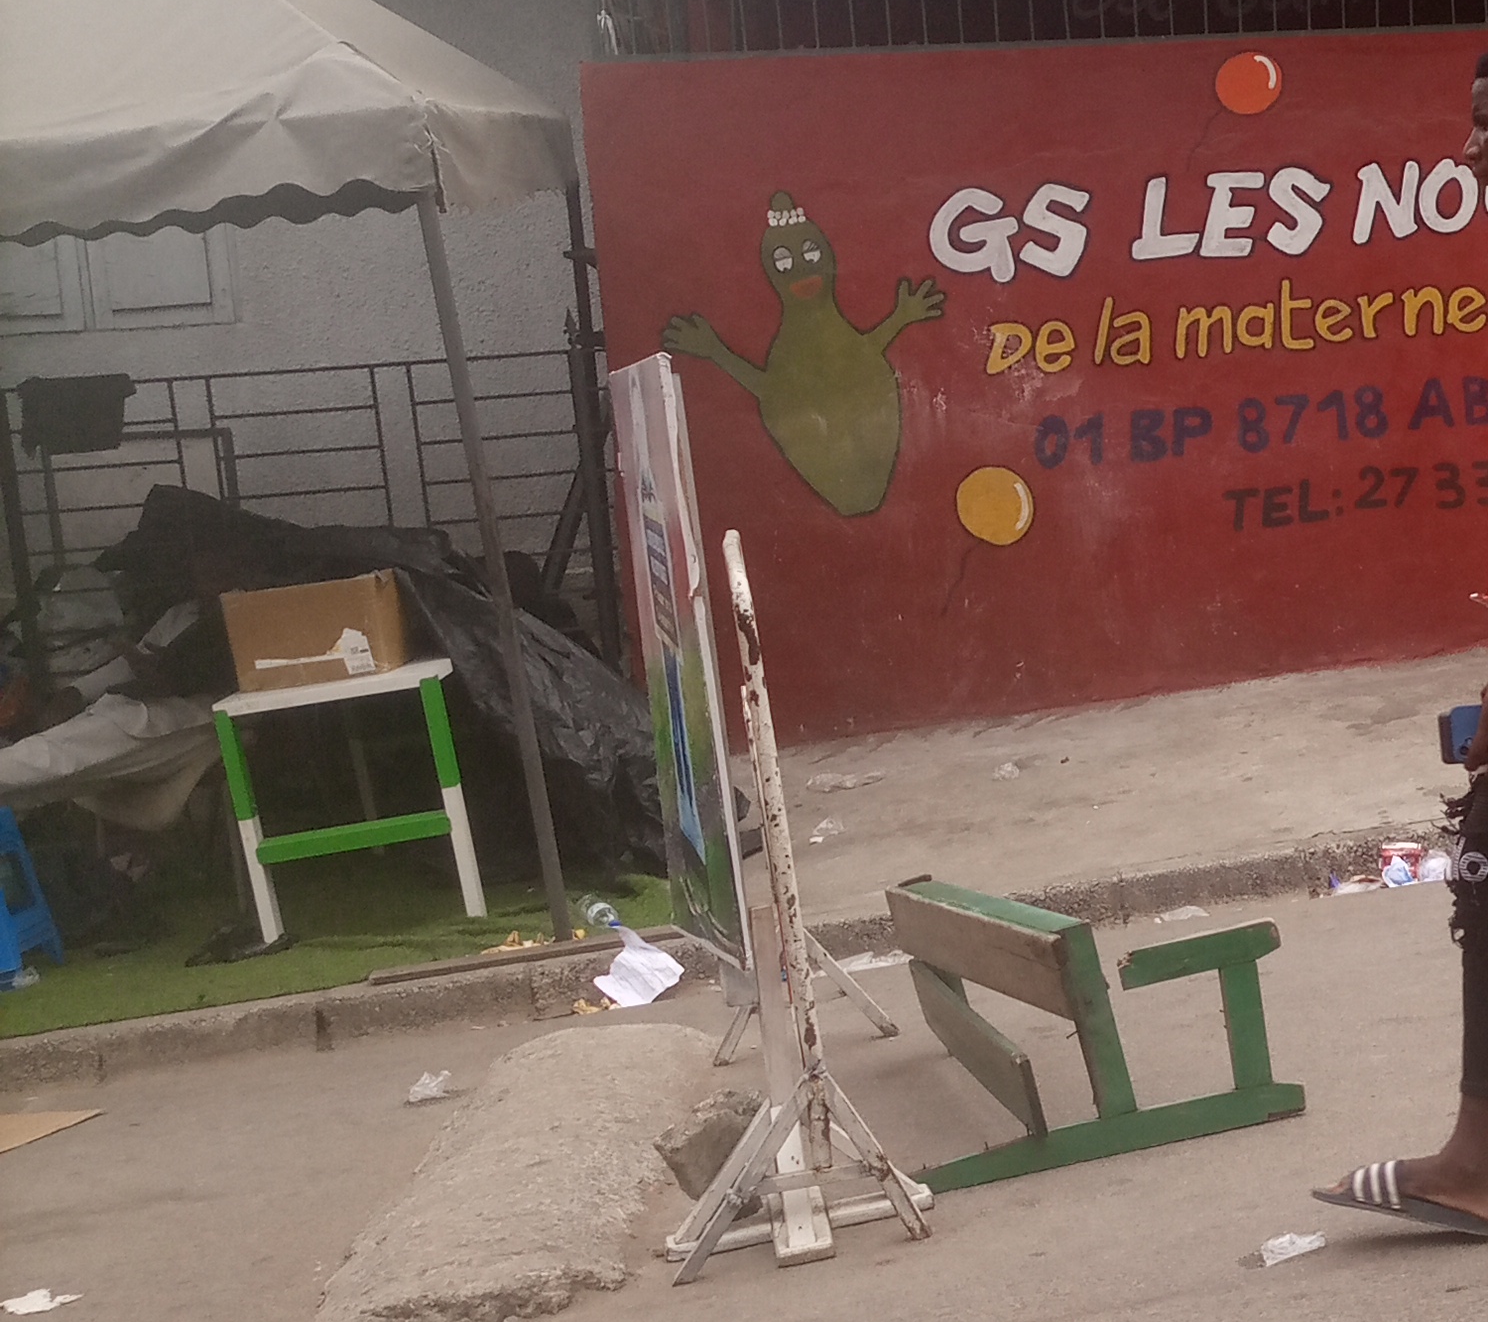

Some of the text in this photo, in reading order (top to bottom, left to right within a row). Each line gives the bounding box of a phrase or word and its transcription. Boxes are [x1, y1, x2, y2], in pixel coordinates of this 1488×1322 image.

[929, 183, 1090, 283] GS
[1131, 167, 1331, 260] LES
[986, 319, 1075, 375] De
[1094, 296, 1151, 365] la
[1034, 414, 1104, 469] 01
[1130, 406, 1213, 462] BP
[1237, 384, 1389, 453] 8718
[1222, 479, 1344, 530] TEL:
